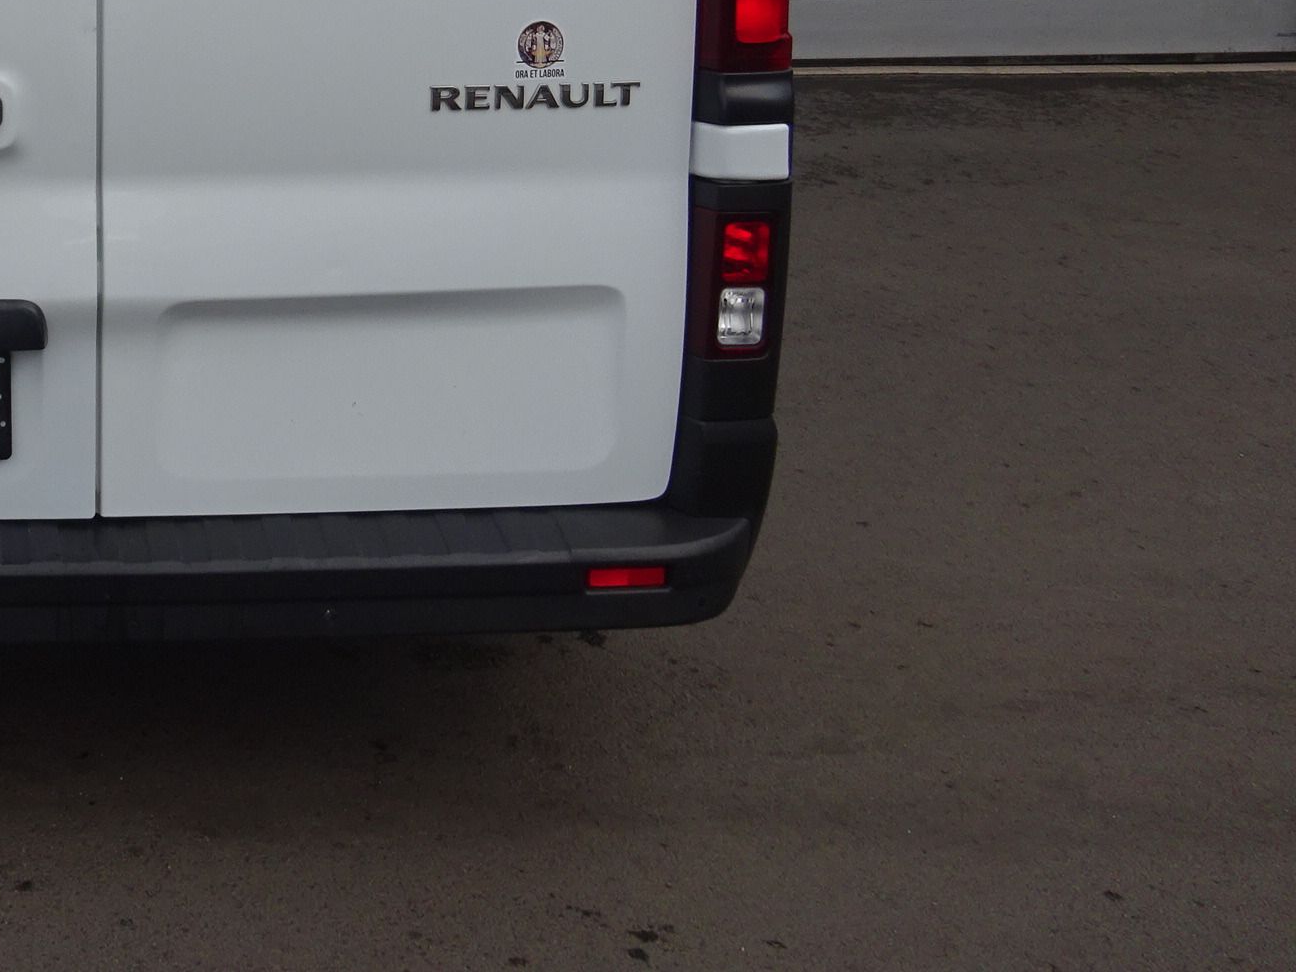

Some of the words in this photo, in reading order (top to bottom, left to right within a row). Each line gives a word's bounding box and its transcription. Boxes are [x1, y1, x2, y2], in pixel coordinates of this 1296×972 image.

[515, 70, 528, 79] ORA
[530, 69, 538, 78] ET
[539, 68, 565, 78] LABORA
[429, 81, 641, 111] RENAULT
